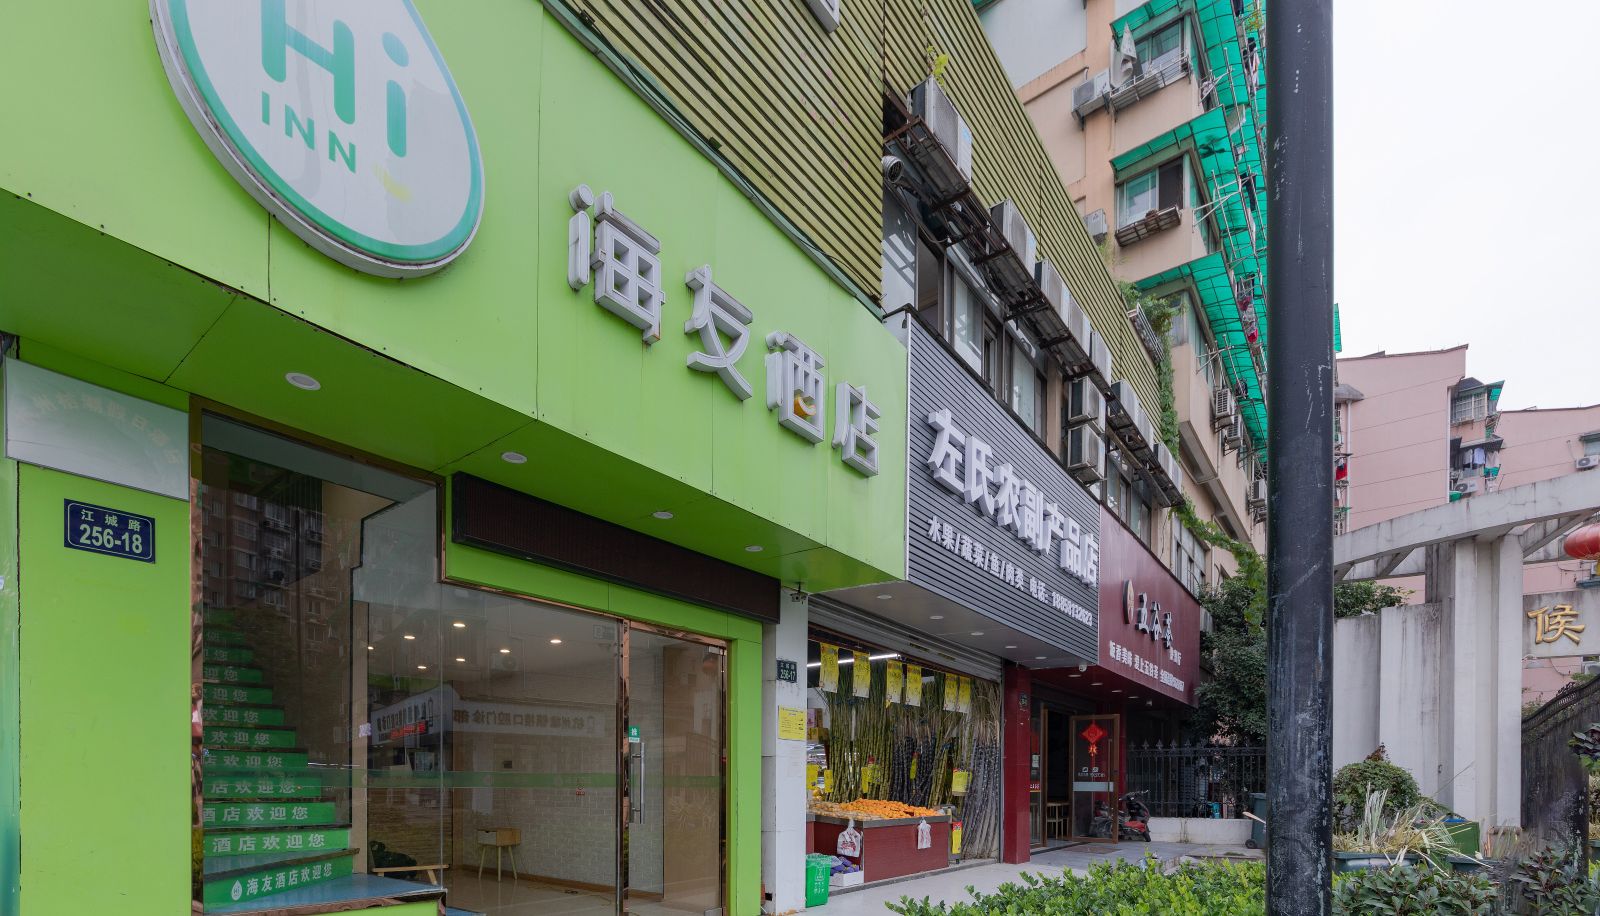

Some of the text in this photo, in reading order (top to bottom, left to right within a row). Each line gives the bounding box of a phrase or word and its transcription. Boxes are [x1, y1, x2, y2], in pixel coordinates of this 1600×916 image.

[261, 0, 407, 158] Hi
[261, 91, 357, 174] INN
[568, 184, 881, 477] 海友酒店
[927, 408, 1098, 588] 左氏农副产品店
[79, 523, 143, 554] 256-18
[81, 508, 141, 532] 江城路
[1527, 604, 1585, 646] 候
[203, 731, 271, 746] 欢迎您
[203, 833, 326, 854] 酒店欢迎您
[246, 862, 333, 896] 海友酒店欢迎您
